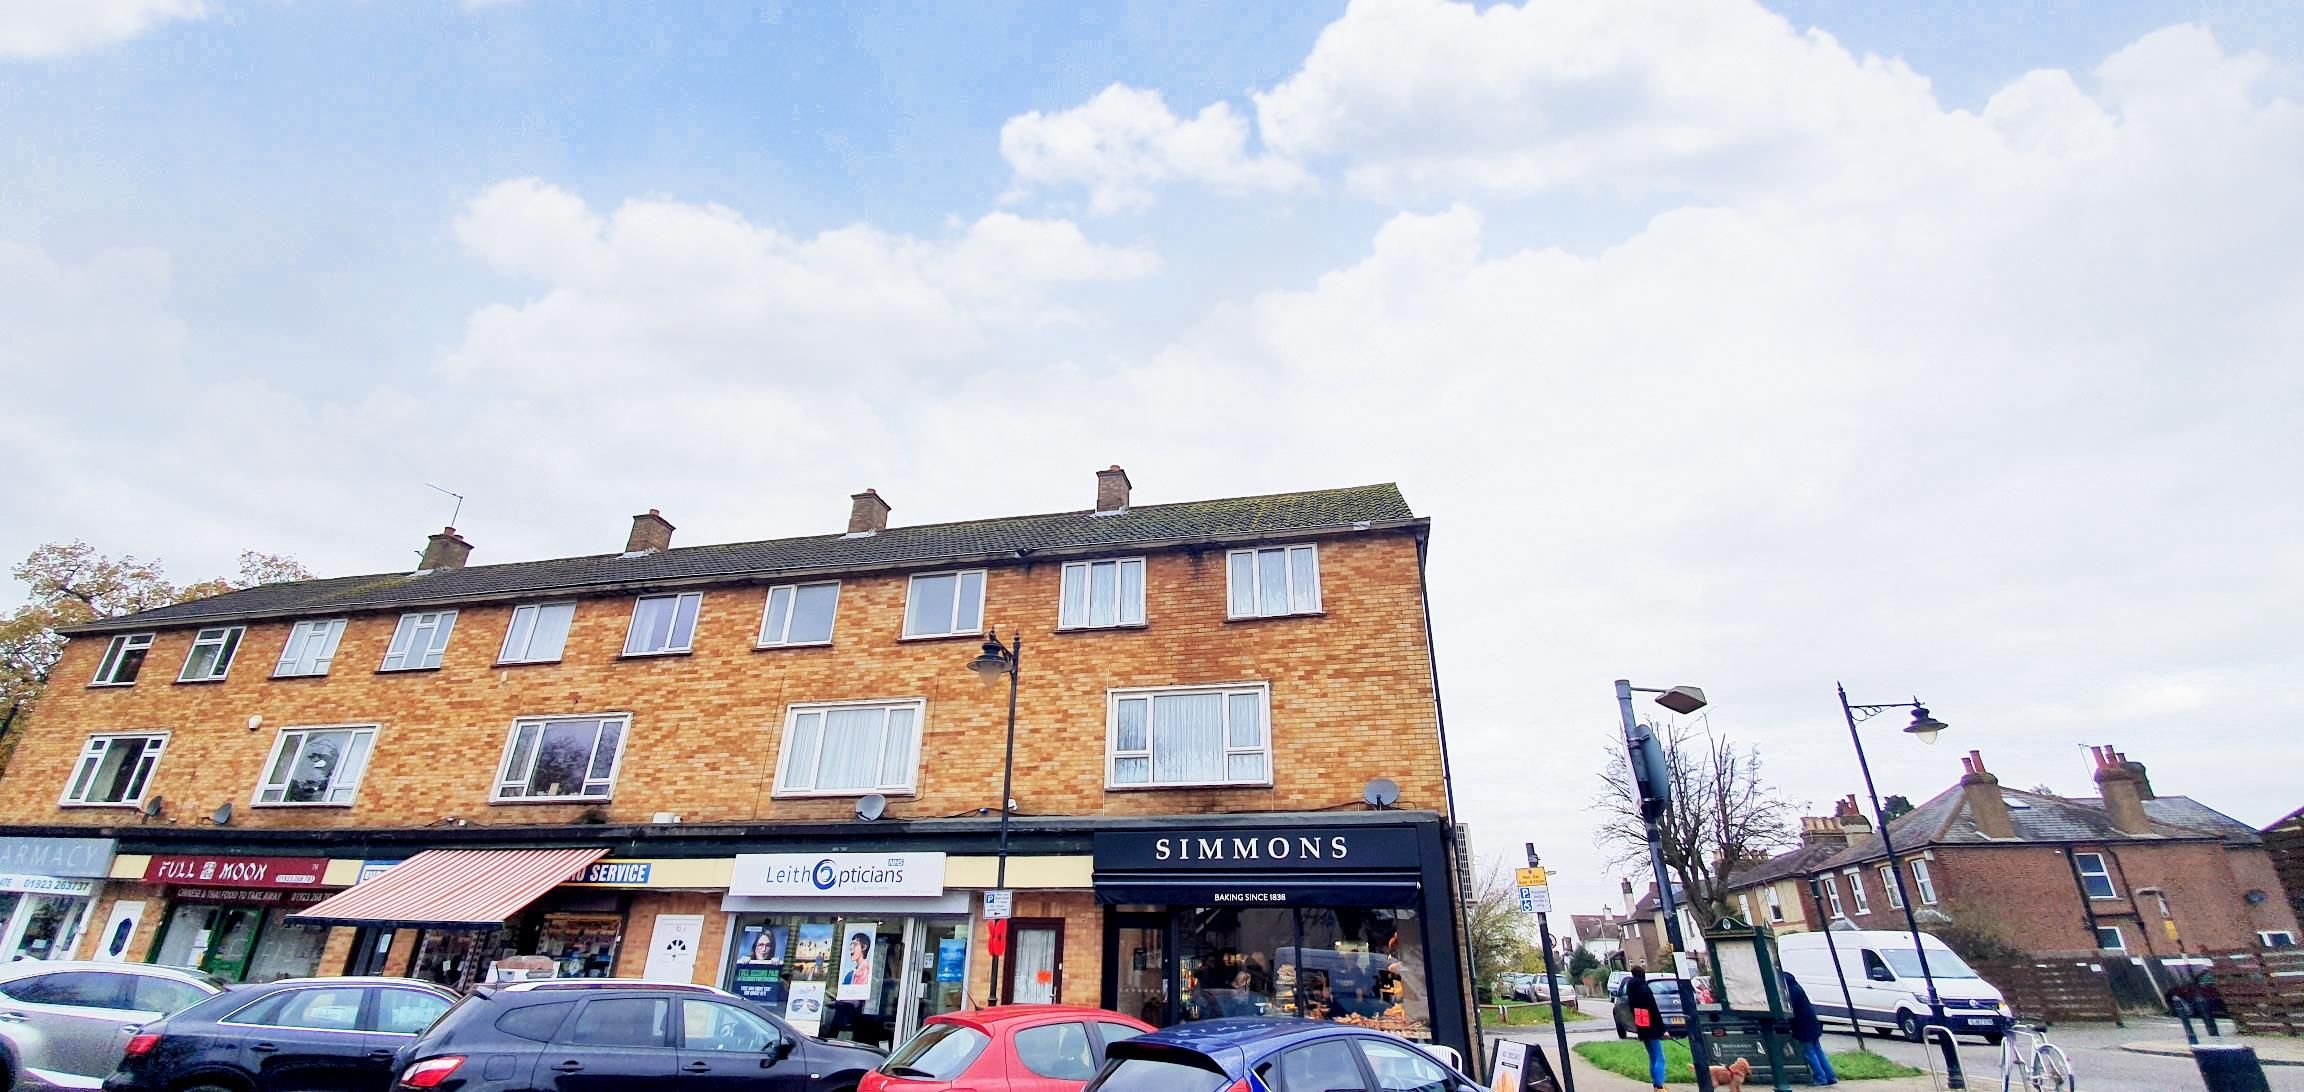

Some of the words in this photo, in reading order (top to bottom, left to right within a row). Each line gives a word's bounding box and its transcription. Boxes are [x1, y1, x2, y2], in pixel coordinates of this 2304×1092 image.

[1155, 836, 1348, 860] SIMMONS
[158, 861, 195, 879] FULL
[218, 862, 268, 881] MOON
[589, 863, 648, 882] SERVICE
[766, 865, 811, 883] Leith
[24, 879, 52, 889] 01923
[54, 880, 90, 891] 263737
[221, 890, 239, 899] FOOD
[239, 890, 248, 900] TO
[1214, 893, 1244, 902] BAKING
[1244, 893, 1268, 902] SINCE
[1269, 893, 1286, 901] 1838
